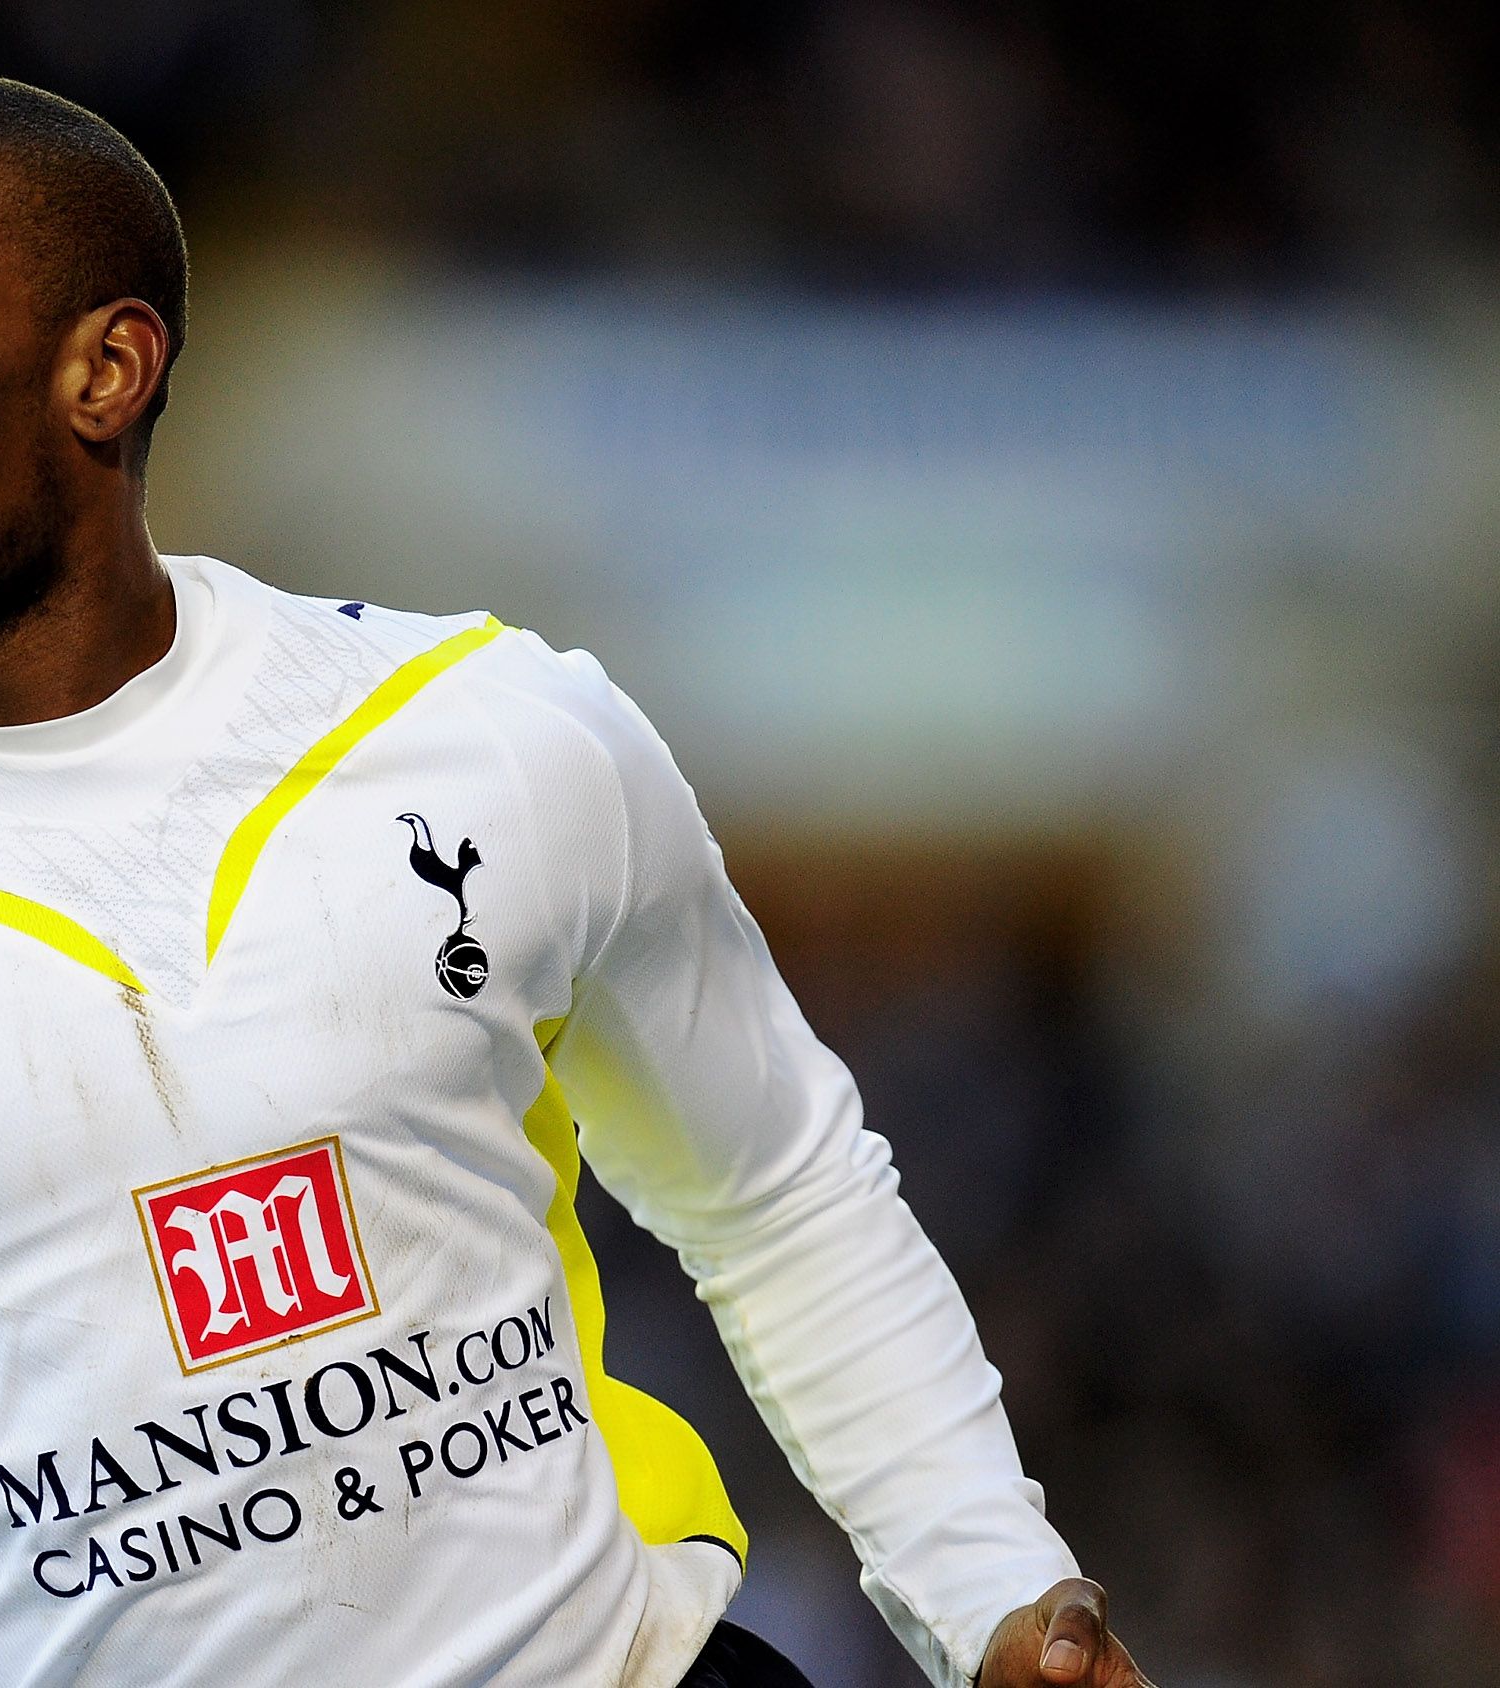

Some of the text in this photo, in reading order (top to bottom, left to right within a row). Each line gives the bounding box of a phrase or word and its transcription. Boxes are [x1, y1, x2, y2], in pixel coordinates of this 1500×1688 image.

[165, 1174, 352, 1342] M
[33, 1376, 588, 1599] CASINO & POKER
